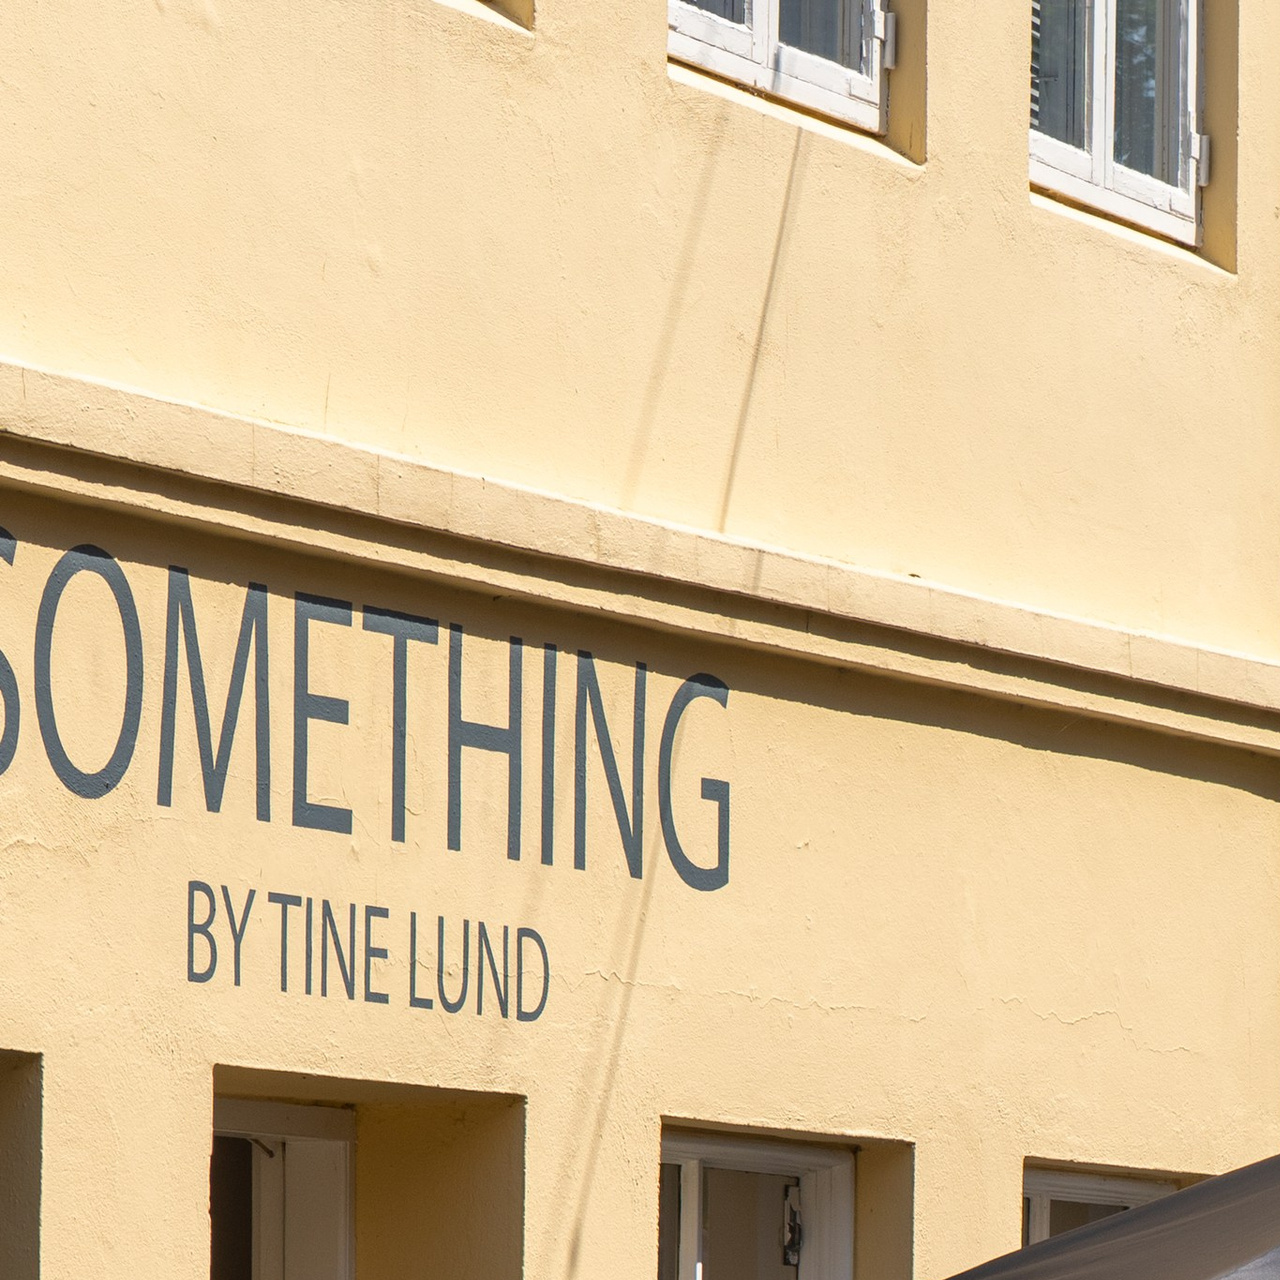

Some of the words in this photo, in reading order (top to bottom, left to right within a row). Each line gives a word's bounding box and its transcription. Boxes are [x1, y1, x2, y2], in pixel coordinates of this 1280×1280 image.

[0, 526, 730, 892] OMETHING
[187, 880, 256, 987] BY
[267, 892, 390, 1005] TINE
[408, 911, 551, 1022] LUND
